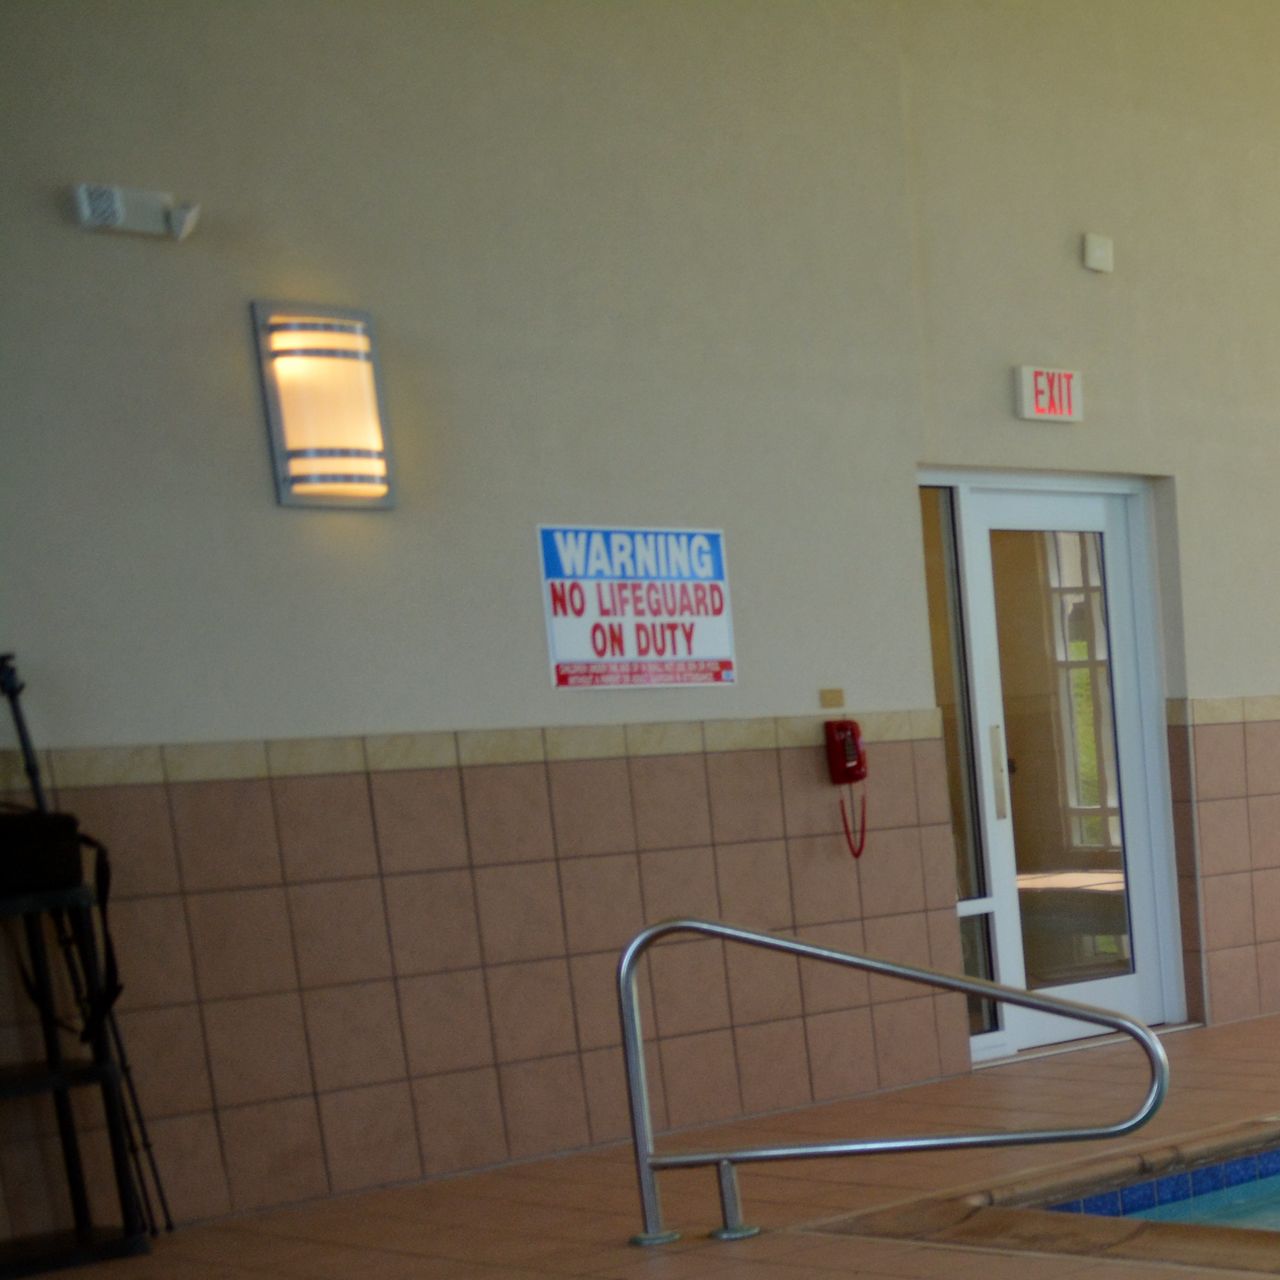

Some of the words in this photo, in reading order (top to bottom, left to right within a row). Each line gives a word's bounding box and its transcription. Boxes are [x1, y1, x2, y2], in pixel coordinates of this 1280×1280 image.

[1033, 371, 1073, 416] EXIT
[552, 531, 714, 578] WARNING
[550, 581, 586, 617] NO
[596, 582, 724, 617] LIFEGUARD
[591, 622, 625, 658] ON
[635, 622, 695, 657] DUTY
